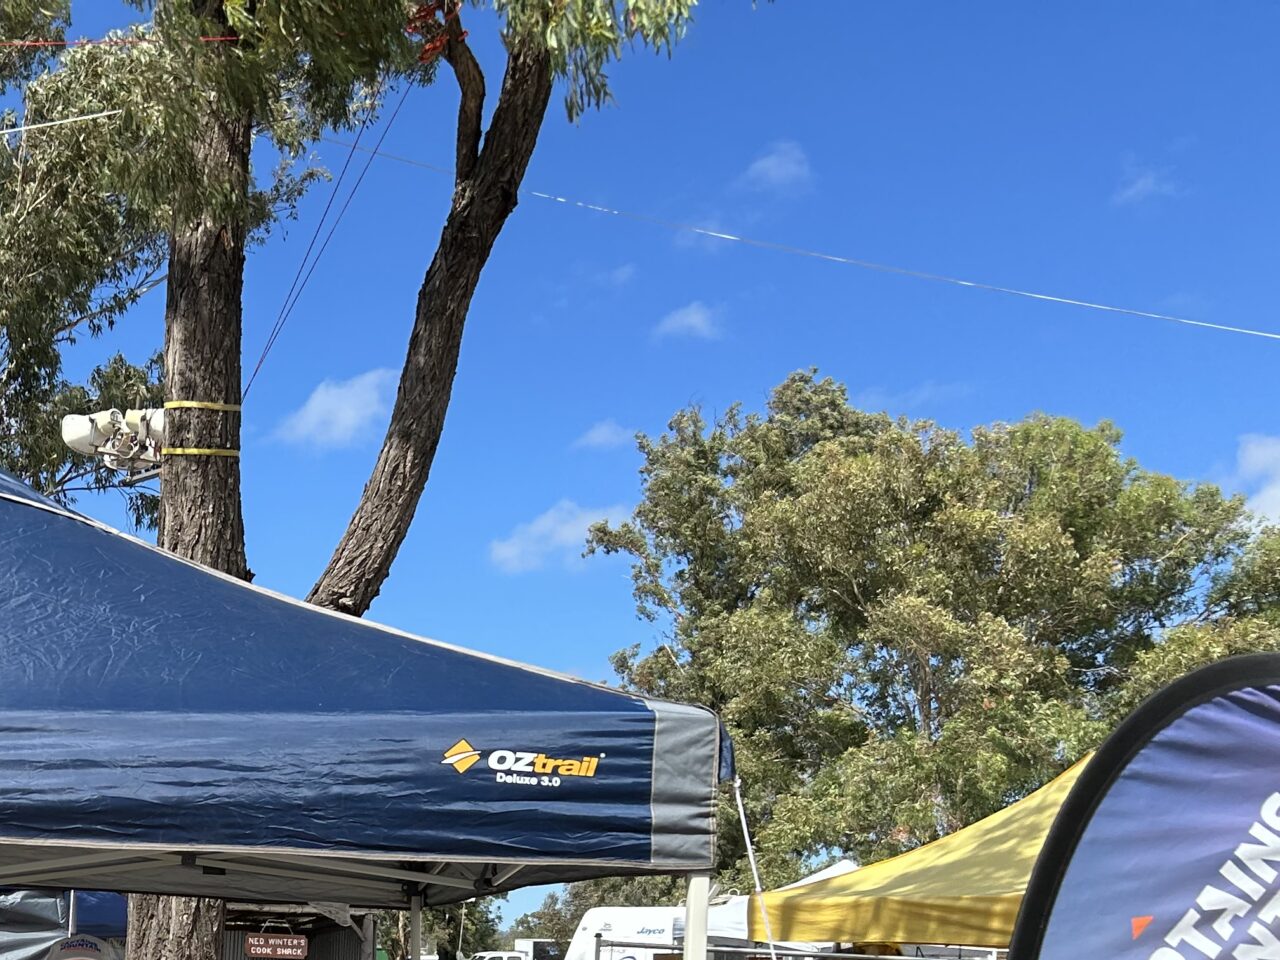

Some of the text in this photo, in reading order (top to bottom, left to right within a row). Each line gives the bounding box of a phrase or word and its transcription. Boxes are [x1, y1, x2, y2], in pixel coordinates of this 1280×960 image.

[487, 749, 599, 777] OZtrail
[496, 772, 561, 787] Deluxe 3.0
[250, 946, 303, 956] COOK SHACK
